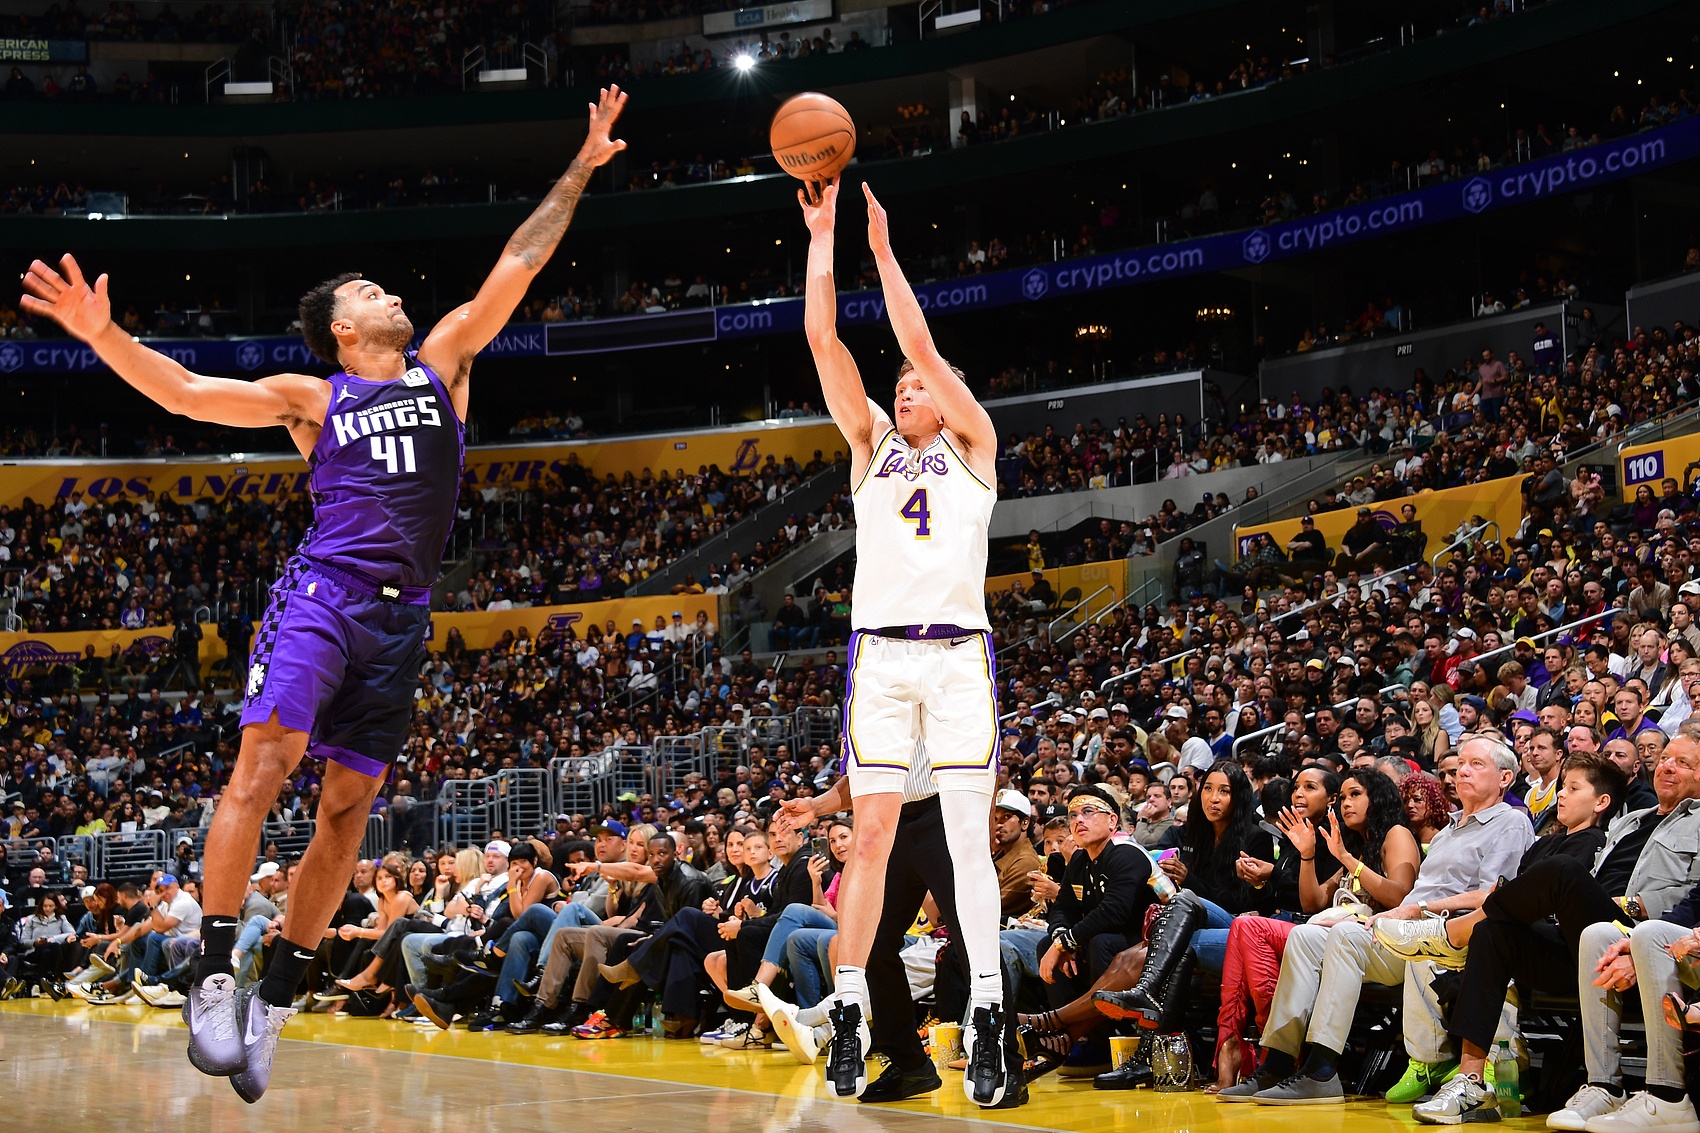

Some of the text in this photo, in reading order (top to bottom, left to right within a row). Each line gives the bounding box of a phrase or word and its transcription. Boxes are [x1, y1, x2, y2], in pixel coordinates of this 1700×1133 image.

[738, 6, 799, 24] UCLA Health
[780, 145, 838, 169] Wilson
[1501, 136, 1666, 196] crypto.com
[1278, 197, 1424, 247] crypto.com
[1056, 246, 1204, 289] crypto.com
[844, 284, 987, 320] cryo.com
[490, 334, 542, 352] BANK
[1397, 344, 1412, 356] PR11
[1047, 399, 1065, 410] PR10
[370, 435, 417, 474] 41
[873, 448, 949, 482] LARS
[1629, 455, 1658, 481] 110
[57, 458, 569, 499] LOS ANGEL KERS
[897, 486, 932, 541] 4
